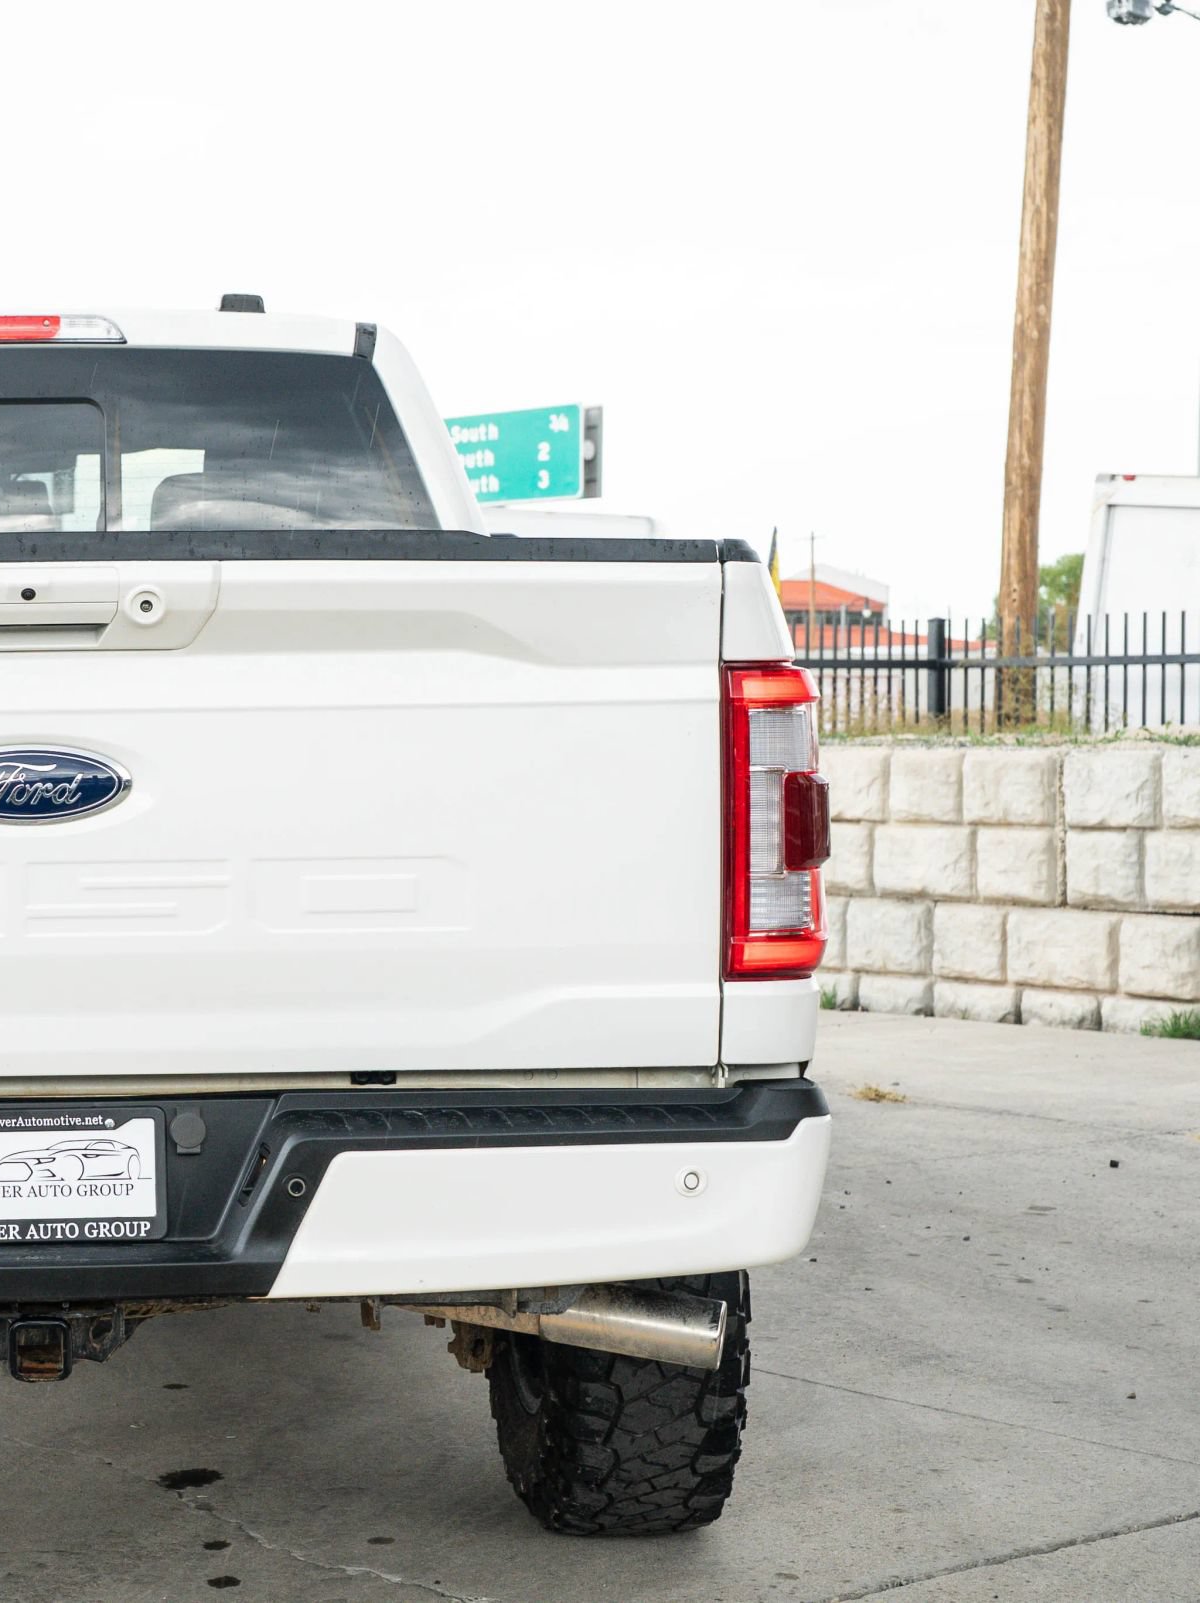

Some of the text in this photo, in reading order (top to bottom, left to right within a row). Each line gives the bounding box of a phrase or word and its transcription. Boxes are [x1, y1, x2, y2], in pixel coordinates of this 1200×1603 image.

[451, 422, 499, 445] South
[537, 441, 551, 462] 2
[537, 469, 550, 489] 3
[27, 1184, 73, 1198] AUTO
[76, 1183, 135, 1197] GROUP
[24, 1222, 80, 1240] AUTO
[83, 1221, 151, 1239] GROUP
